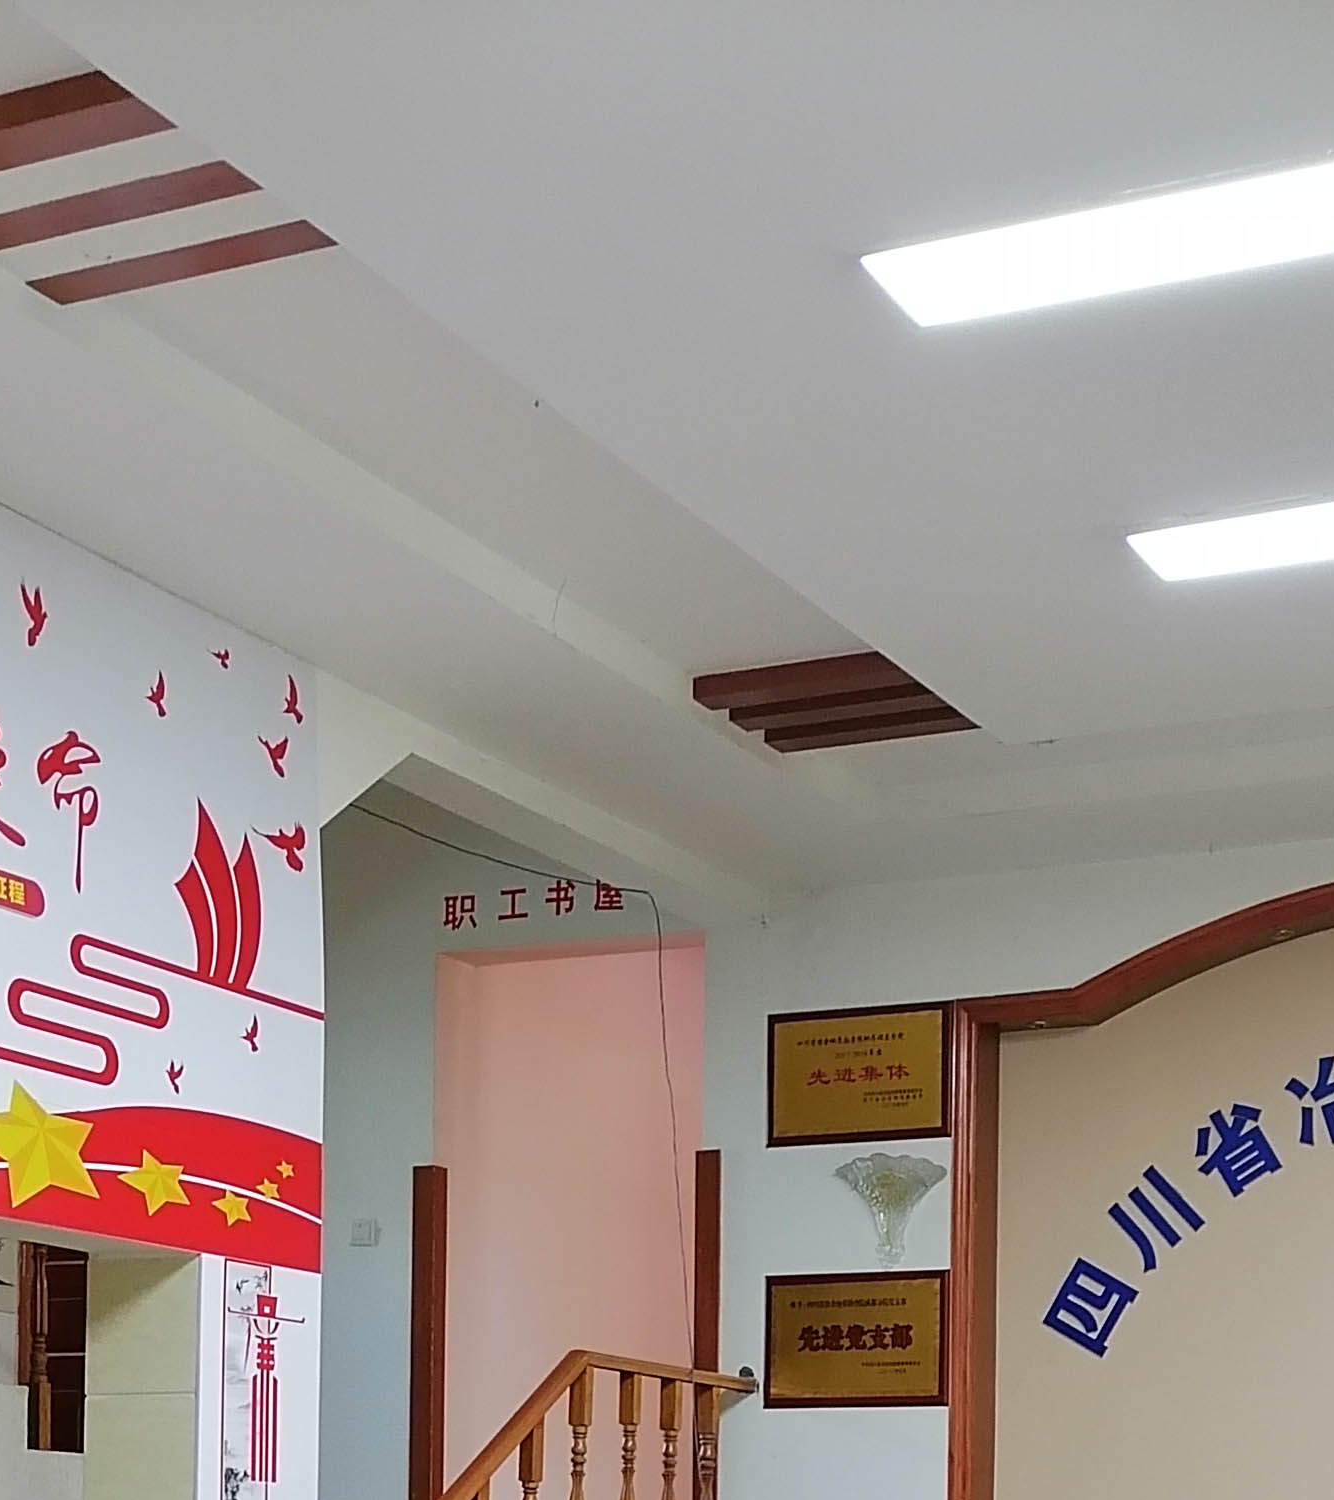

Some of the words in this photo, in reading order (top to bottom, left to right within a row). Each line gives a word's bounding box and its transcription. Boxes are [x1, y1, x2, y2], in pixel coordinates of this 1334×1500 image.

[443, 879, 624, 931] 职工书屋
[807, 1063, 910, 1086] 先进集体
[798, 1323, 913, 1352] 先进党支部
